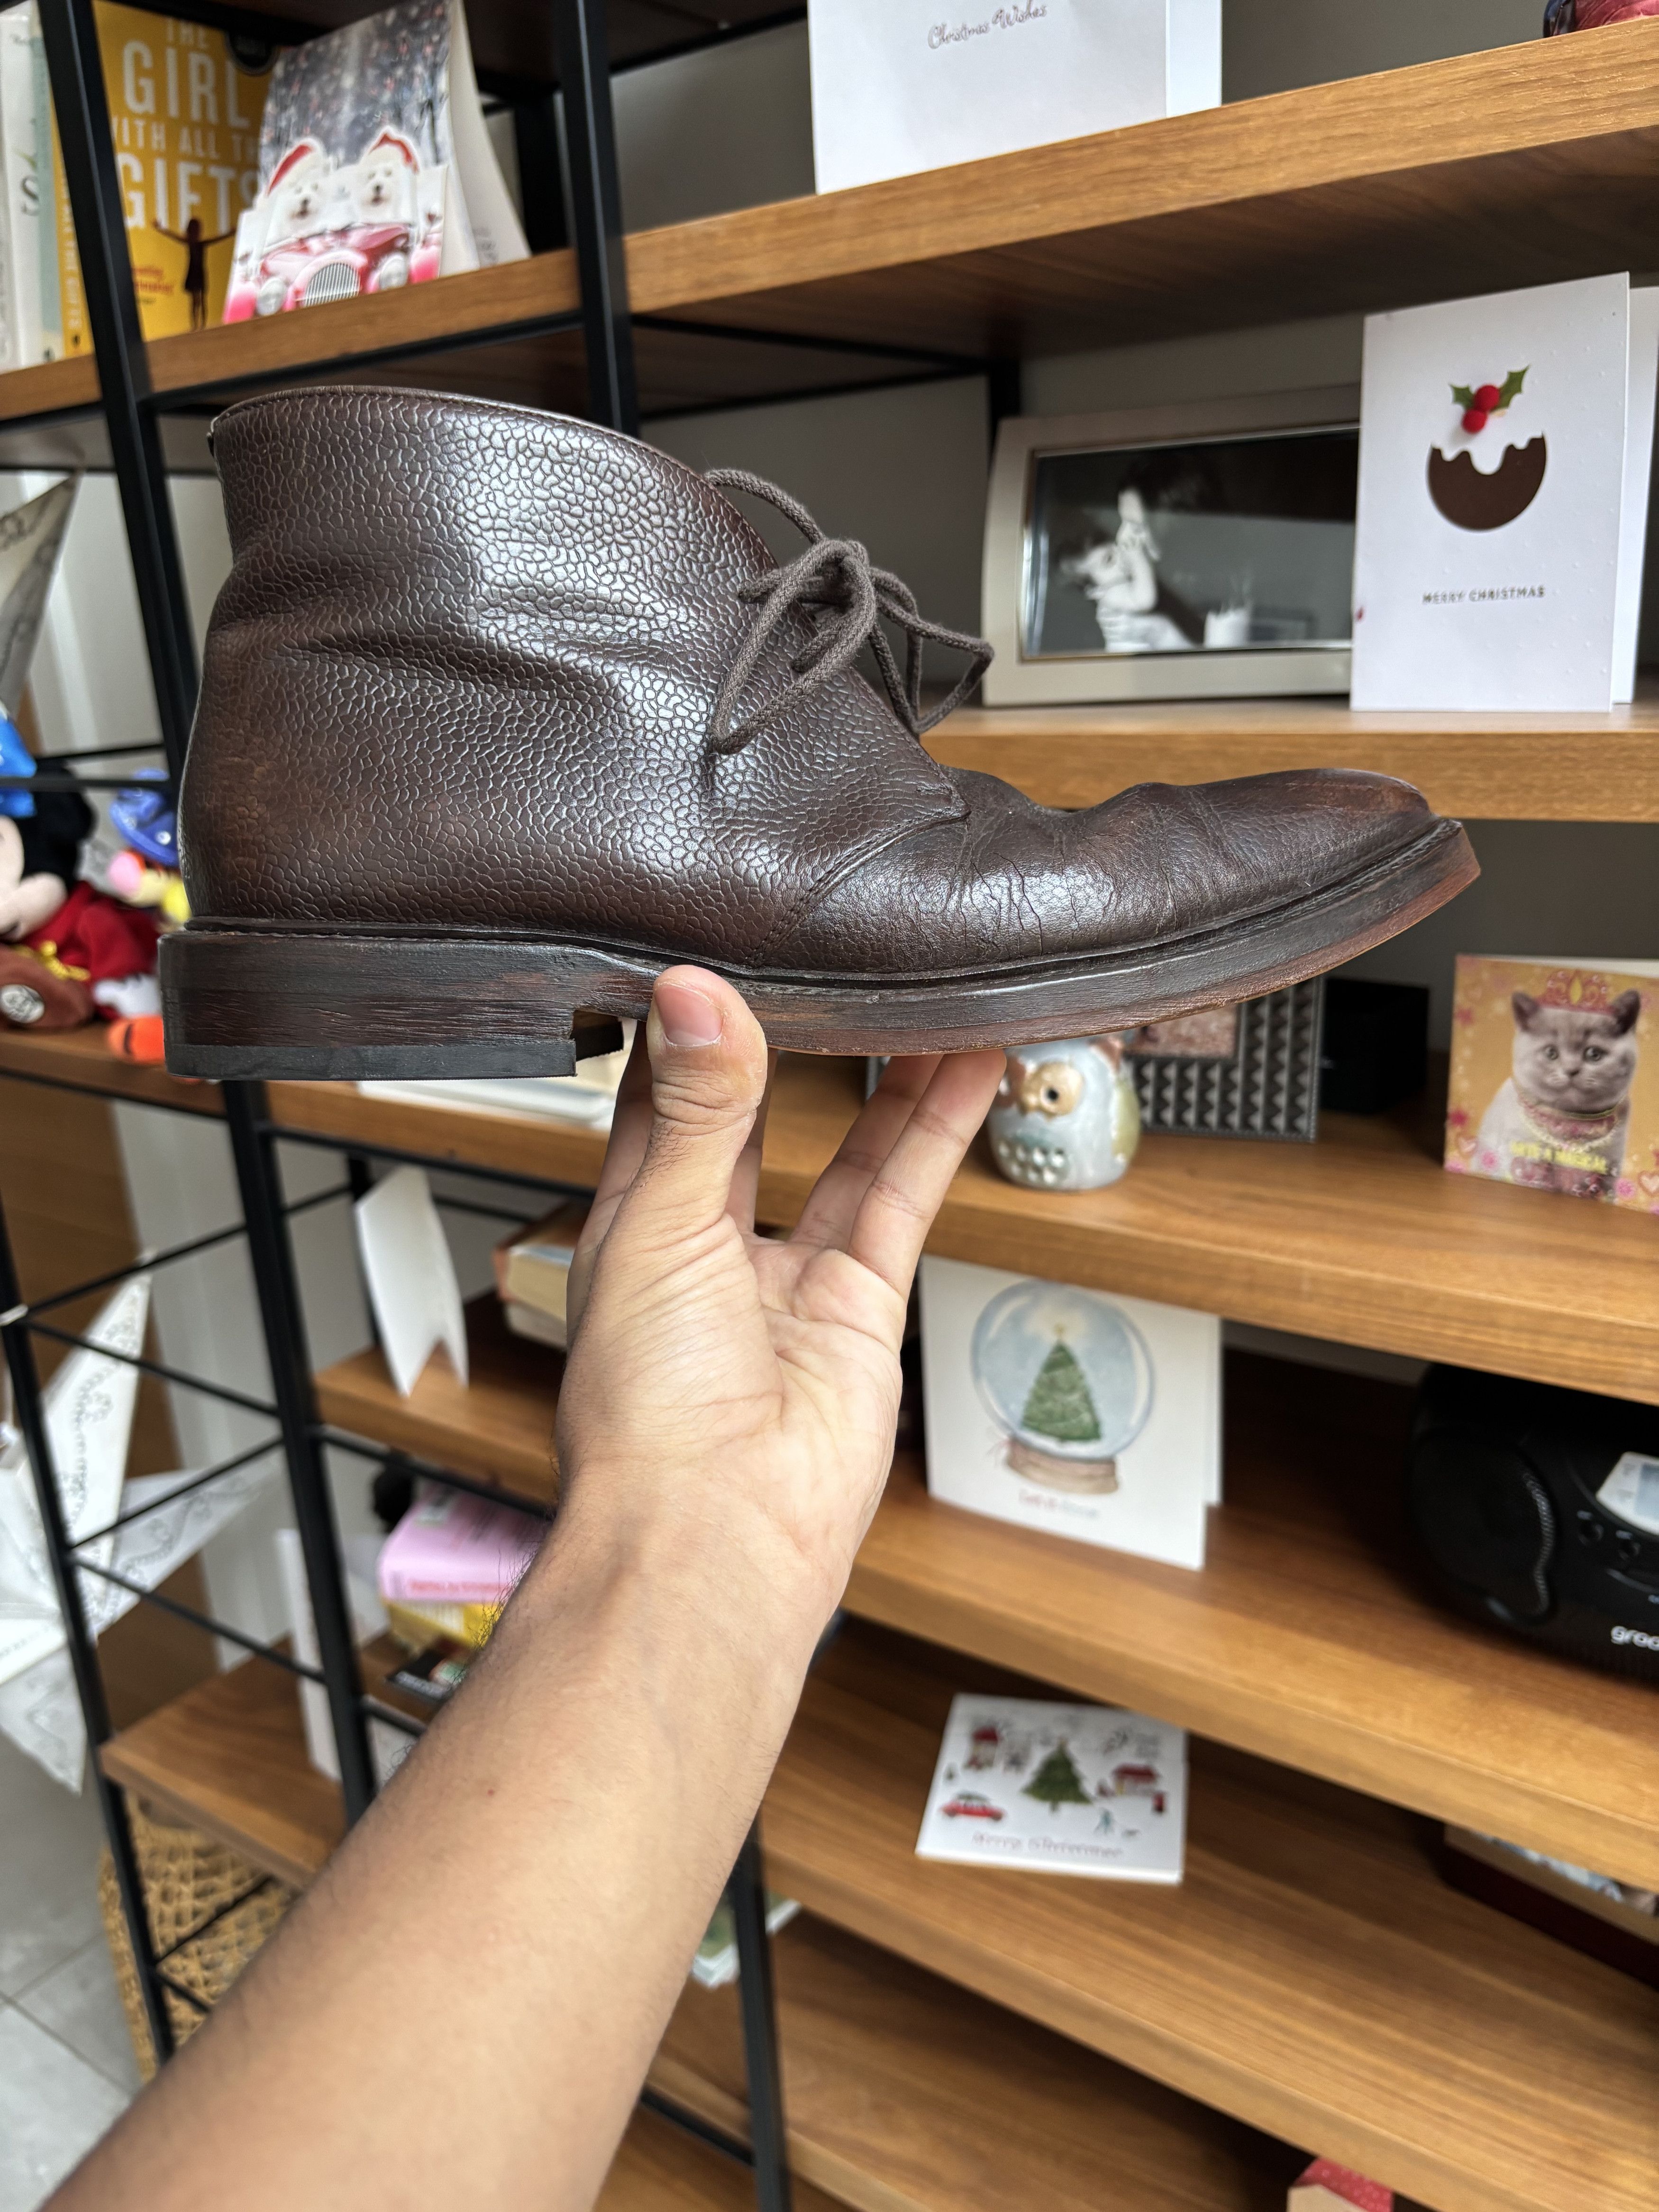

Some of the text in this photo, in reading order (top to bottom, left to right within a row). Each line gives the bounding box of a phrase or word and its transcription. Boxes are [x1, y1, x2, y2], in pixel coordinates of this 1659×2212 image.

[167, 18, 207, 49] THE
[928, 22, 991, 49] Christmas
[123, 40, 252, 128] GIRL
[178, 125, 219, 160] ALL
[1422, 584, 1546, 606] MERRY CHRISTMAS
